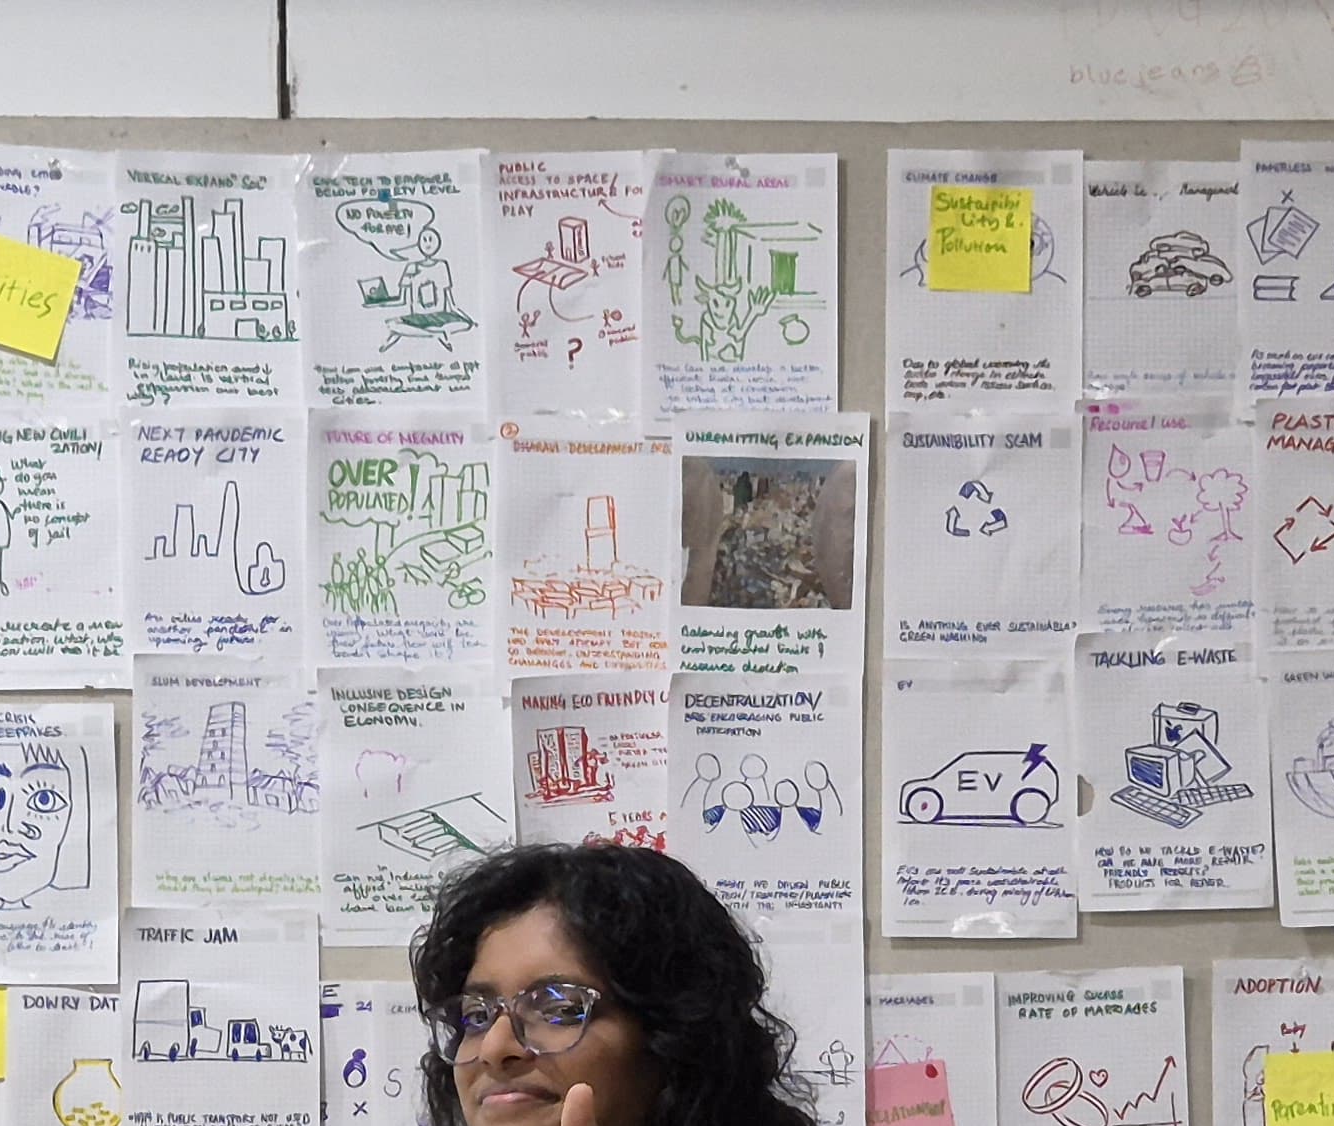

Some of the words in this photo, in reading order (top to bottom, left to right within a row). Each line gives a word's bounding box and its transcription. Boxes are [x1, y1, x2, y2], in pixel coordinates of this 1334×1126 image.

[137, 425, 186, 443] NEXT
[194, 425, 285, 443] PANDEMIC
[784, 432, 864, 447] EXPANSION
[1004, 432, 1043, 450] SCAM
[140, 446, 205, 467] READY
[215, 446, 260, 464] CITY
[328, 459, 397, 488] OVER
[1090, 648, 1166, 669] TACKLING
[1177, 647, 1237, 666] E-WASTE
[330, 687, 393, 701] INCLUSIVE
[396, 686, 452, 701] DESIGN
[450, 702, 465, 712] IN
[957, 770, 1003, 792] EV
[138, 927, 194, 944] TRAFFIC
[203, 927, 238, 945] JAM
[1233, 975, 1322, 995] ADOPTION
